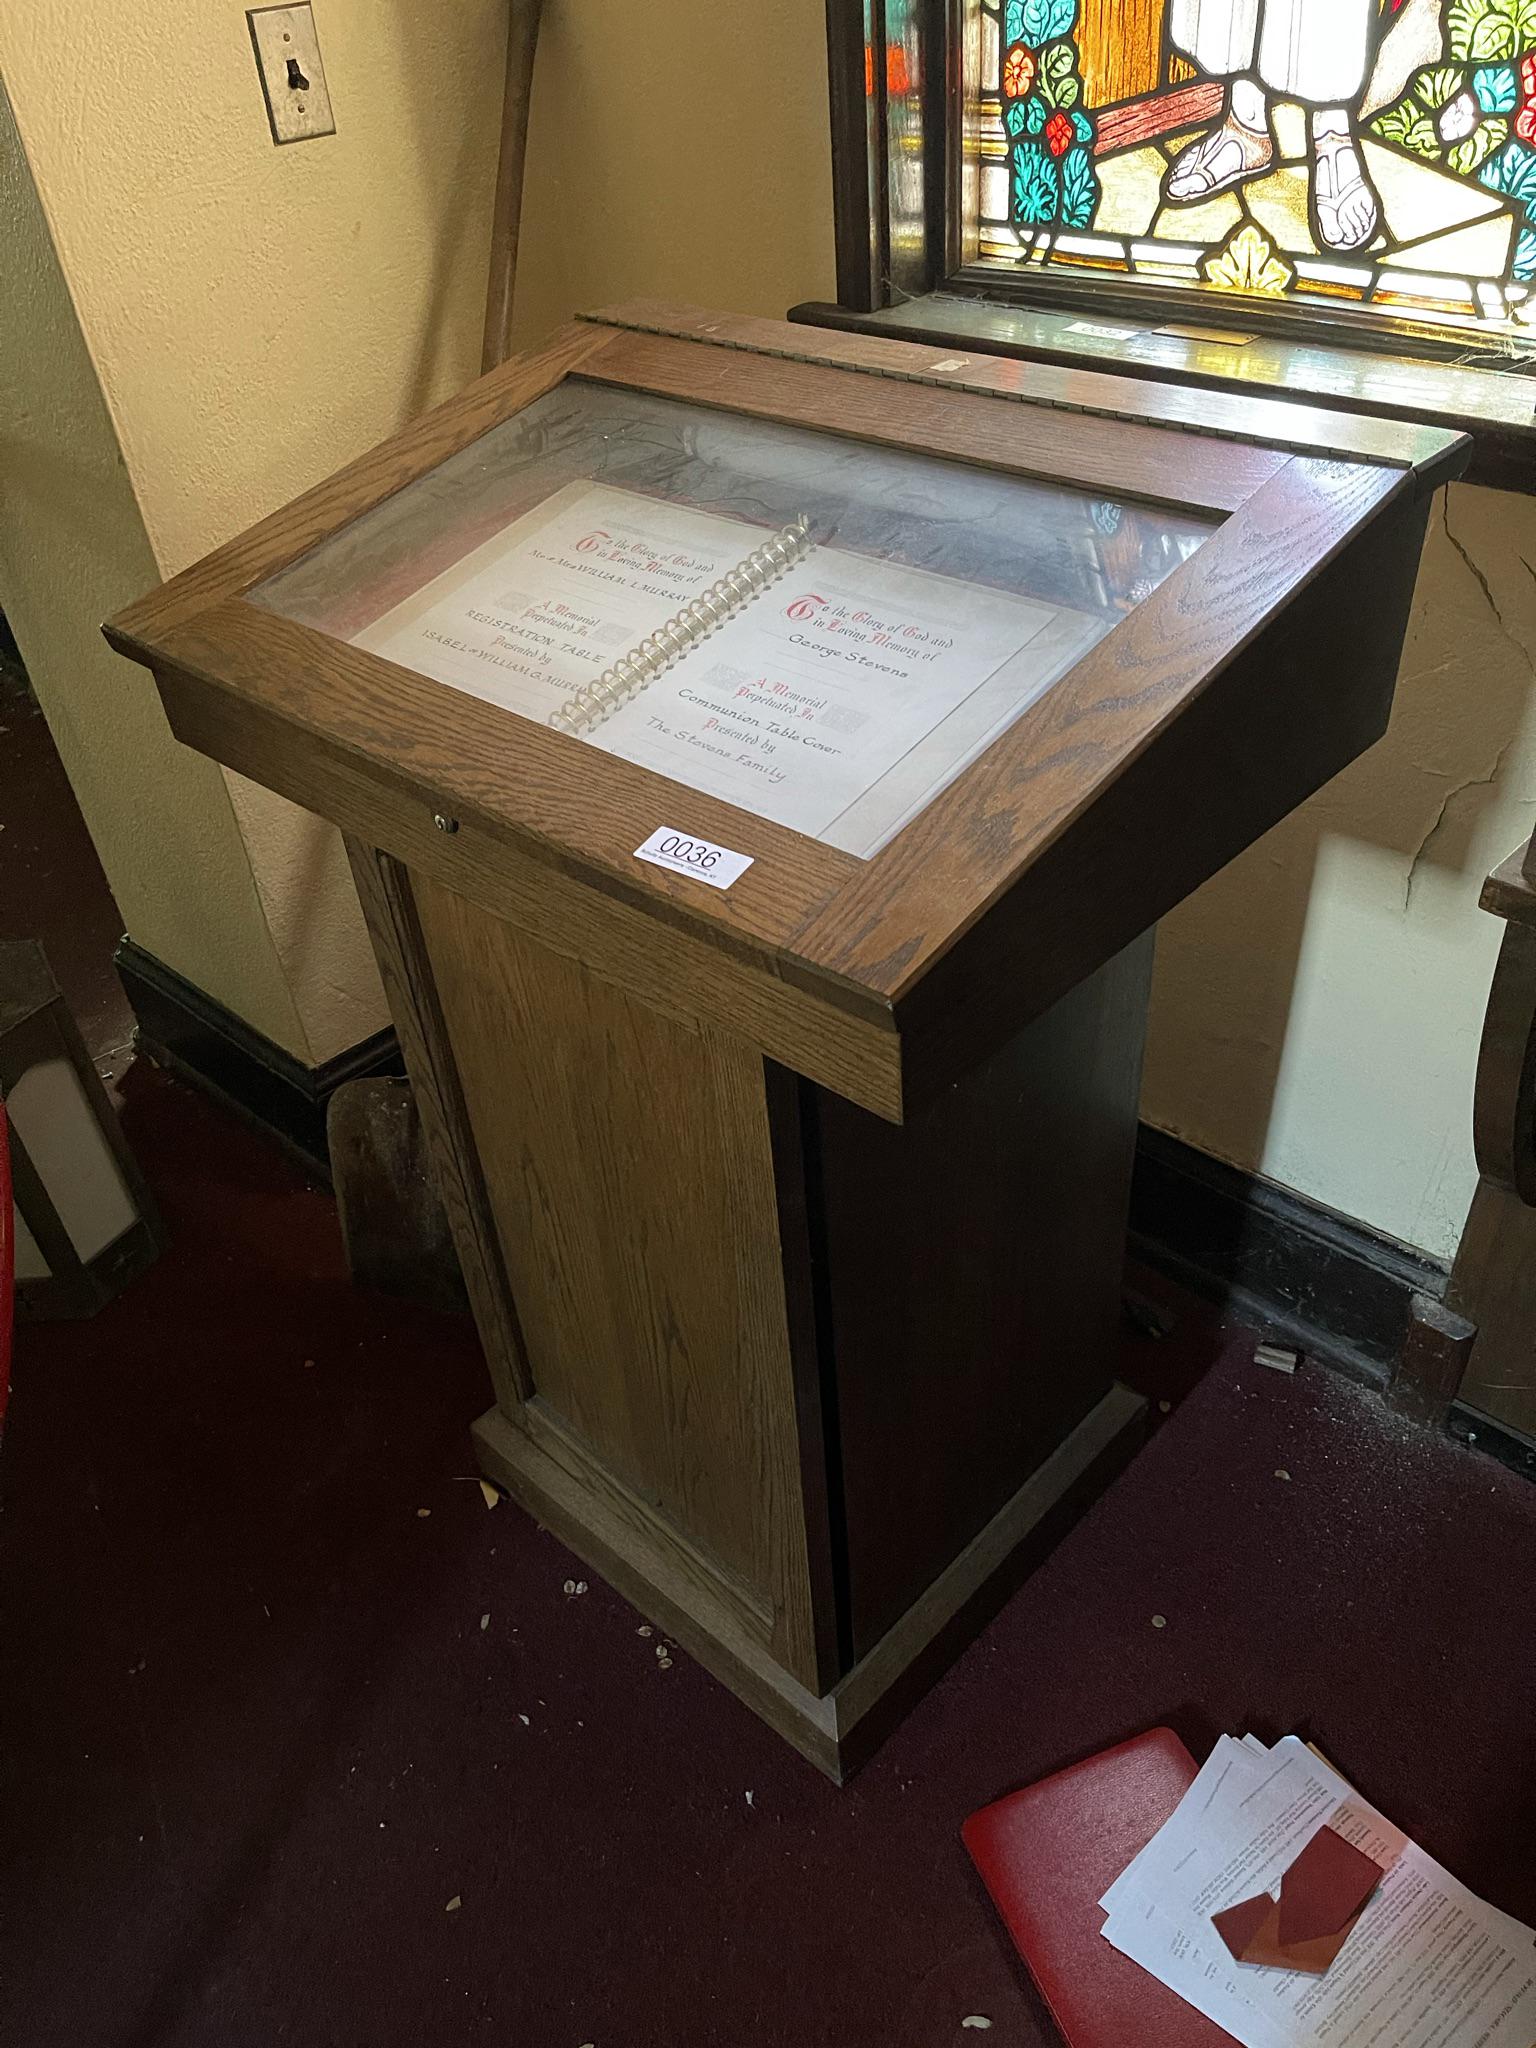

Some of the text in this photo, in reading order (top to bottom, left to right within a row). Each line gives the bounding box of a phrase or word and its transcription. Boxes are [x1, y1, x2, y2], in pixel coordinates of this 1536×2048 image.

[574, 530, 715, 574] To the Glory of God and
[597, 550, 703, 584] in Loving Memory of
[520, 608, 589, 638] Perpetuated In
[535, 600, 601, 627] A Memorial
[785, 593, 953, 649] To the Glory of God and
[422, 629, 467, 652] ISABEL
[476, 650, 531, 677] WILLIAM
[465, 609, 607, 664] REGISTRATION TABLE
[489, 635, 553, 665] Presented by
[788, 633, 909, 678] George Stevens
[812, 617, 942, 662] in Loving Memory of
[732, 686, 814, 721] Perpetuated In
[751, 677, 828, 710] A Memorial
[678, 688, 842, 756] Communion Table Cover
[702, 717, 777, 755] Presented by
[646, 716, 786, 784] The Stevens Family
[659, 835, 722, 869] 0036
